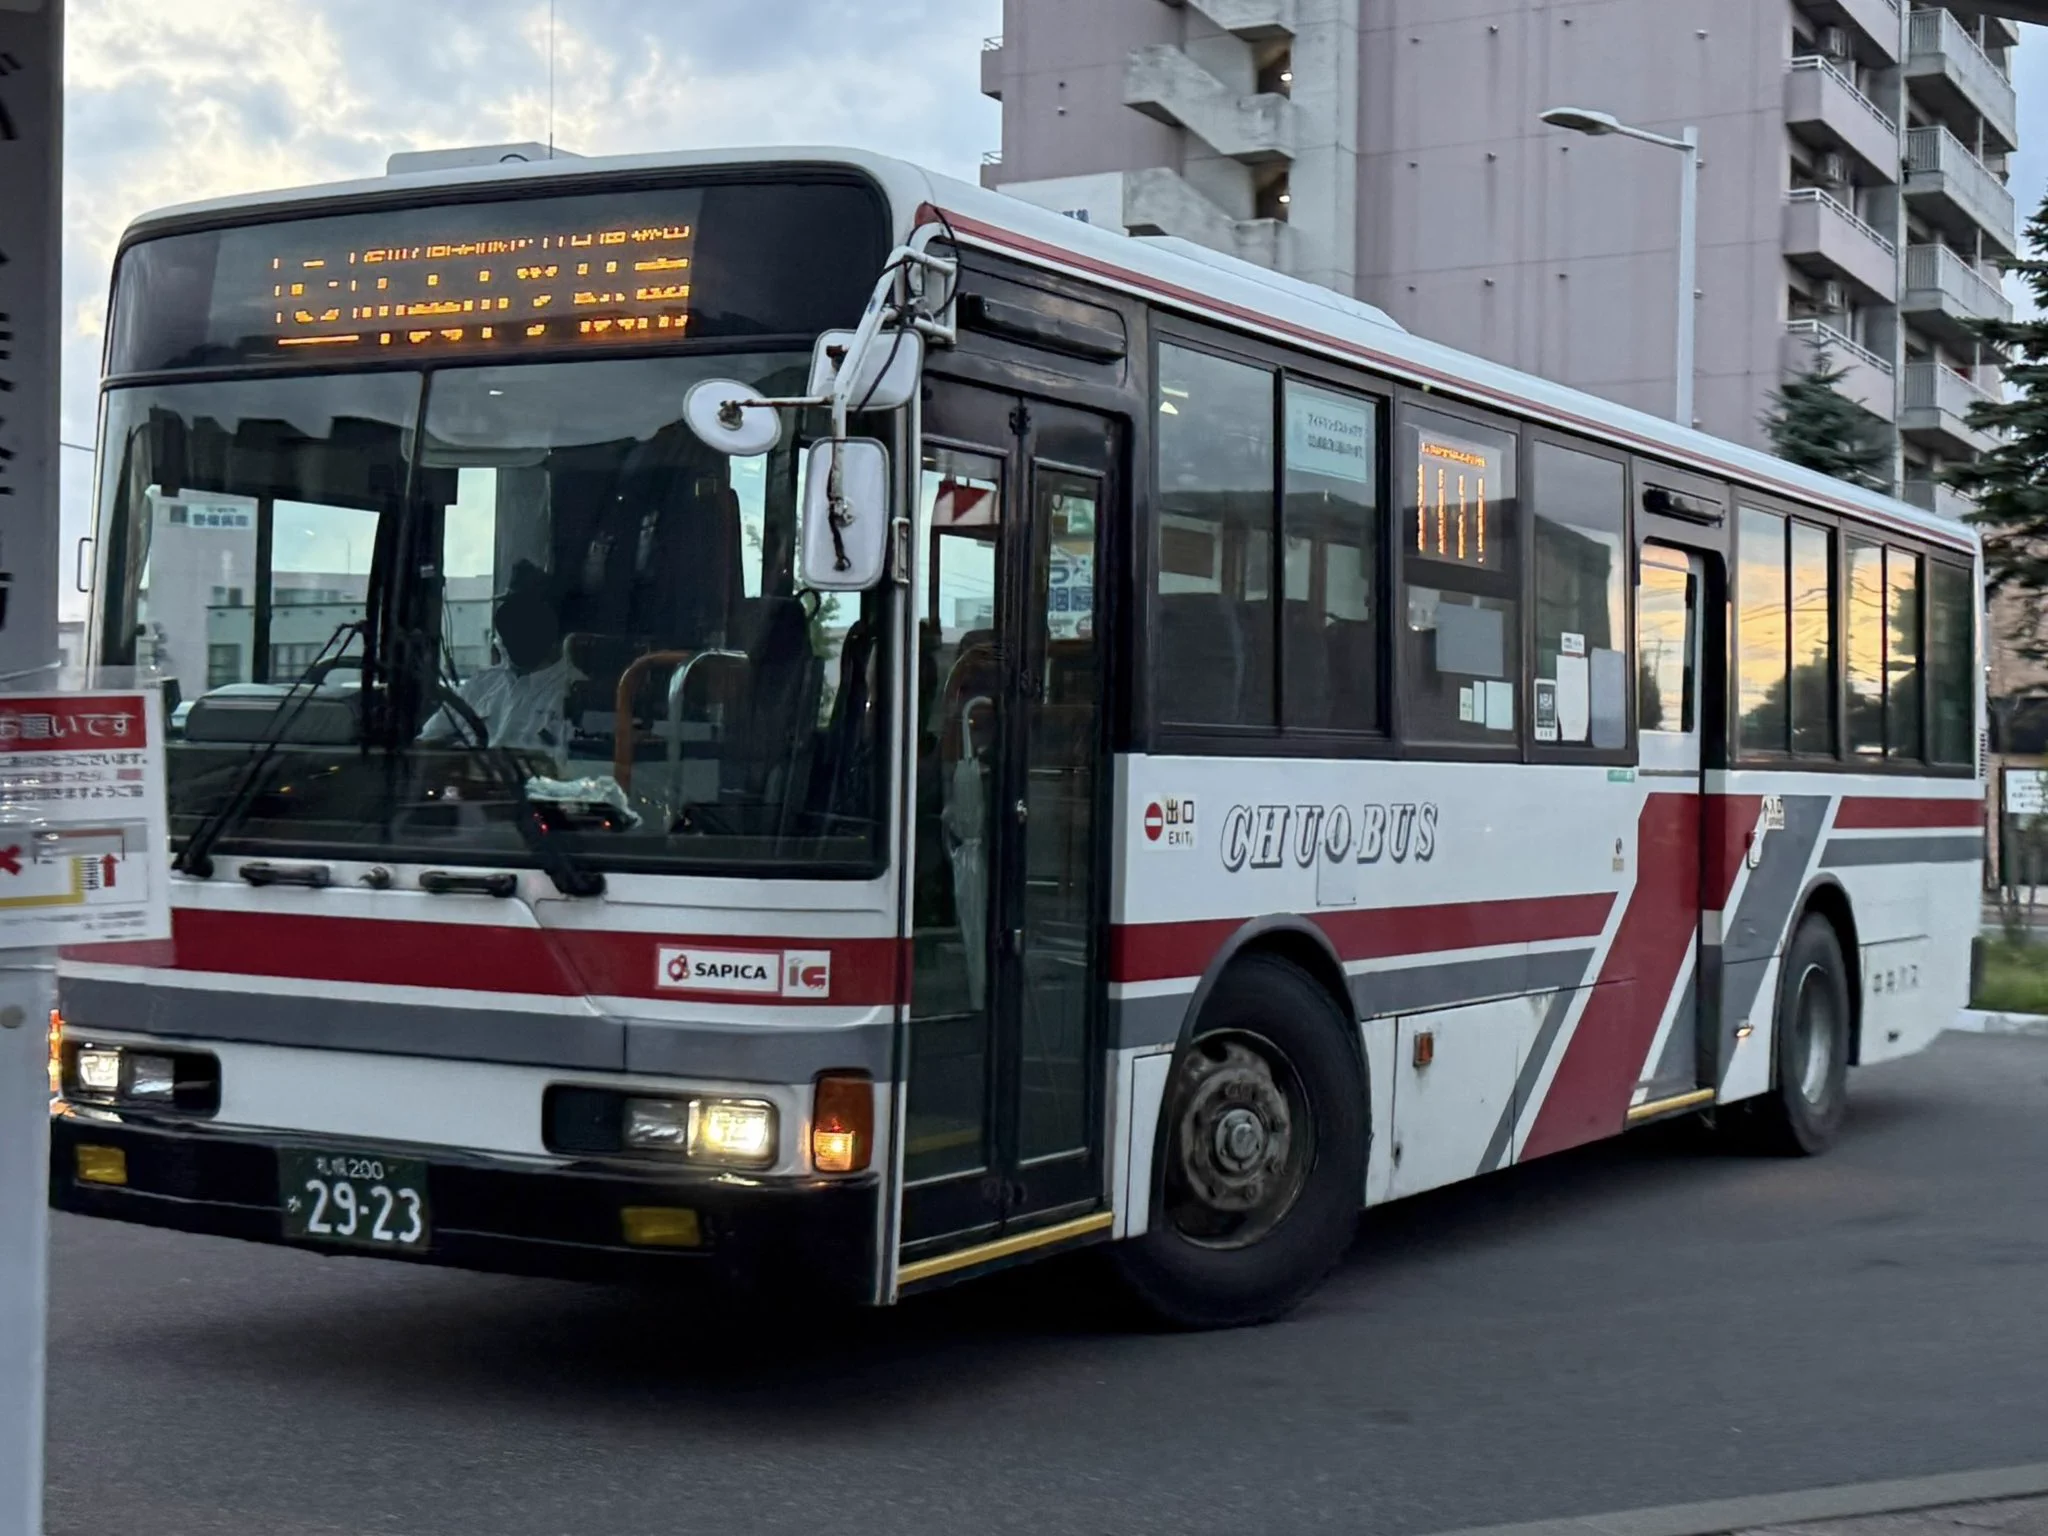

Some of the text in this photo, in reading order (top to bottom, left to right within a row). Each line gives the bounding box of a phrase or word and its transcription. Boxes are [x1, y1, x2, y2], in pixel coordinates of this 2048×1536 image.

[1166, 799, 1194, 824] 出口
[1168, 831, 1191, 845] EXIT
[694, 961, 768, 981] SAPICA
